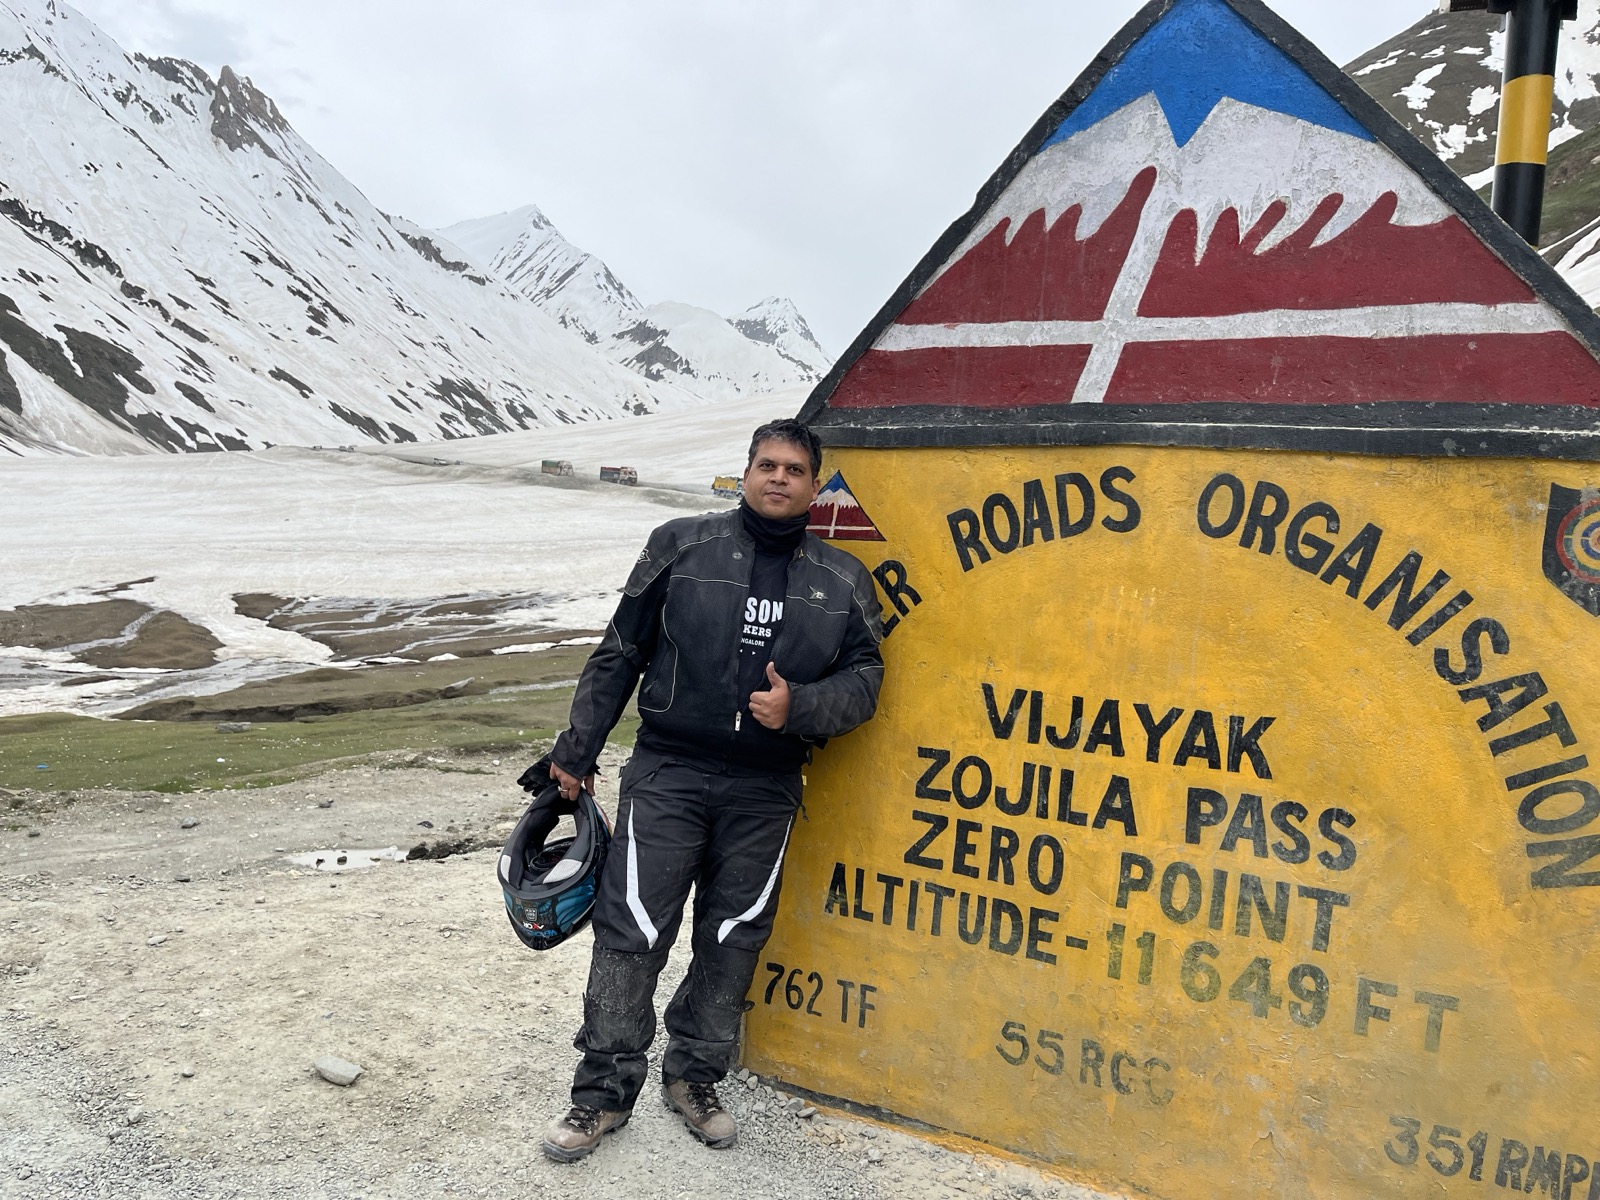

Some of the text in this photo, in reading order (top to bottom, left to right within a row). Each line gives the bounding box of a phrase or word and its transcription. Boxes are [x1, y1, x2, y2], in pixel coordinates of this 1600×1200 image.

[742, 624, 772, 638] KERS
[744, 596, 784, 624] SON
[946, 465, 1142, 573] ROADS
[1197, 472, 1600, 890] ORGANISATION
[981, 682, 1277, 780] VIJAYAK
[915, 746, 1358, 872] ZOJILA PASS
[903, 810, 1351, 953] ZERO POINT
[763, 961, 878, 1029] 762 TF
[1494, 1136, 1600, 1200] RMP
